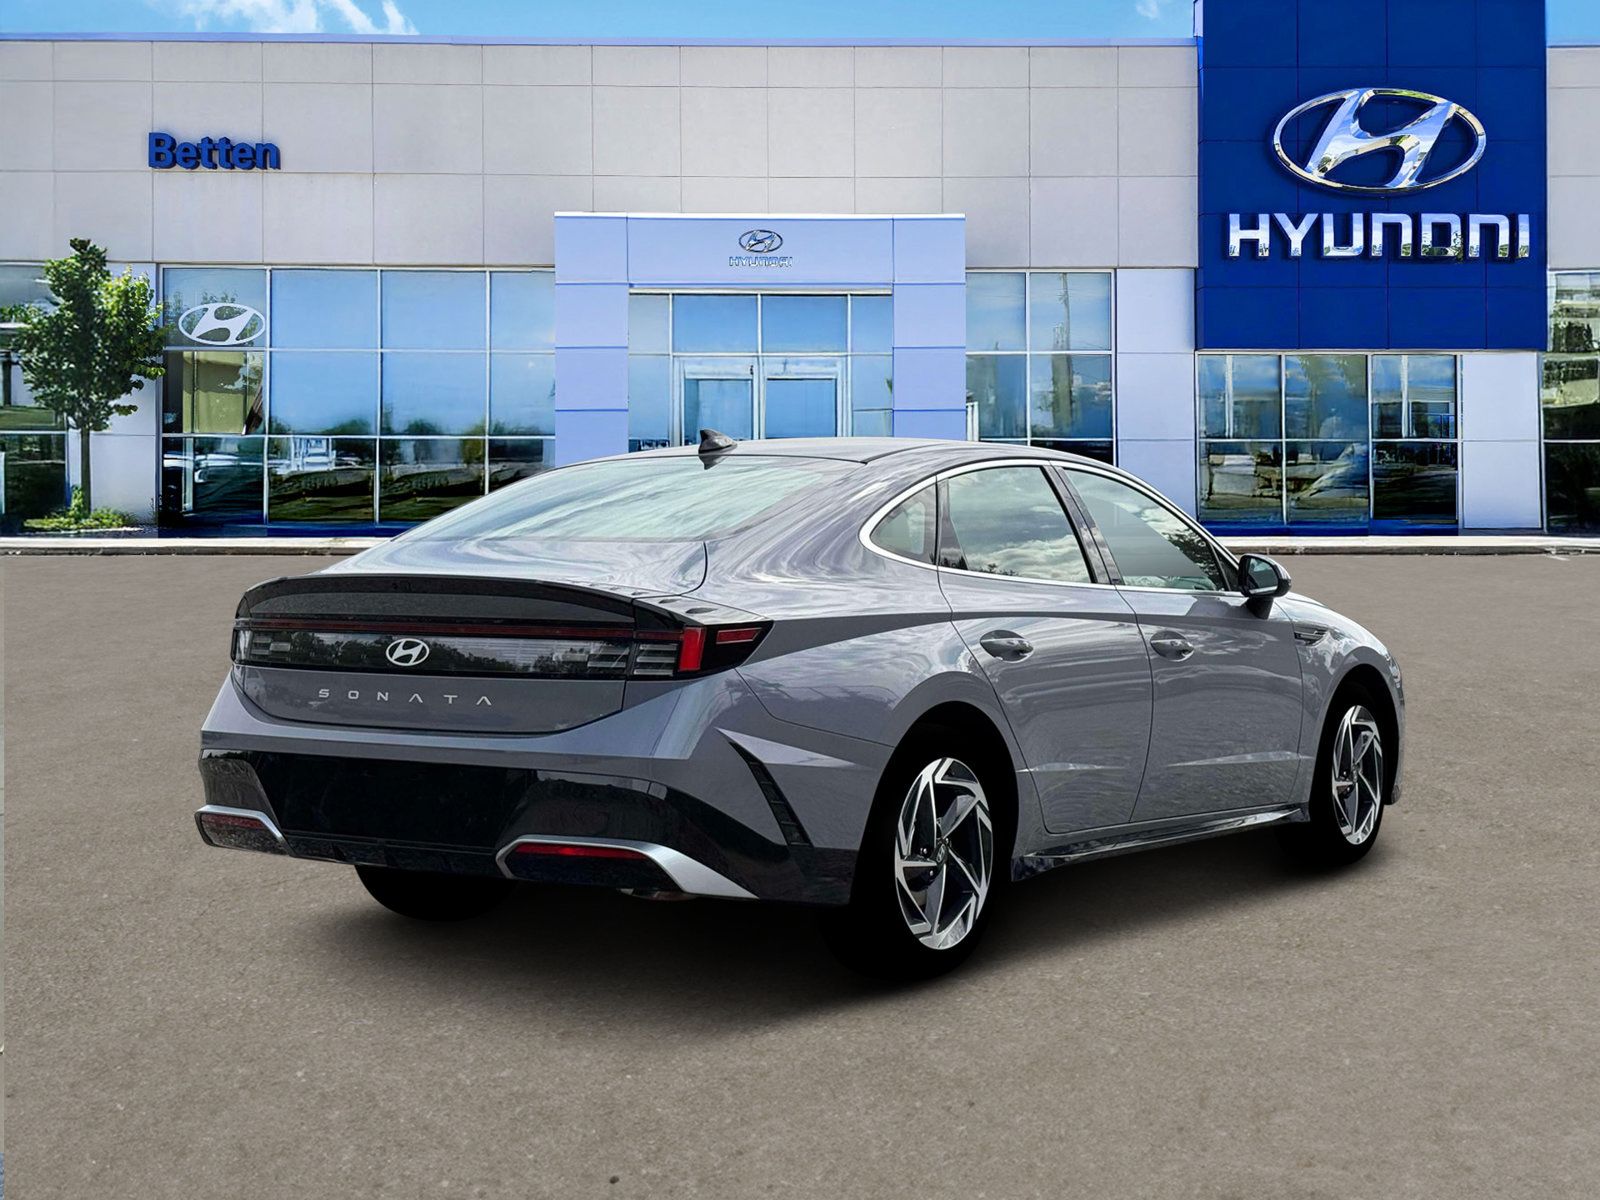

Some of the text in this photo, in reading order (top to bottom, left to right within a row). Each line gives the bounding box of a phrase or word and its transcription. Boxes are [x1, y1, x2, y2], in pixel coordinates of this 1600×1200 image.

[148, 132, 281, 170] Betten
[1228, 213, 1530, 258] HYUNDAI
[728, 256, 793, 267] HYUNDAI
[318, 688, 492, 706] SONATA
